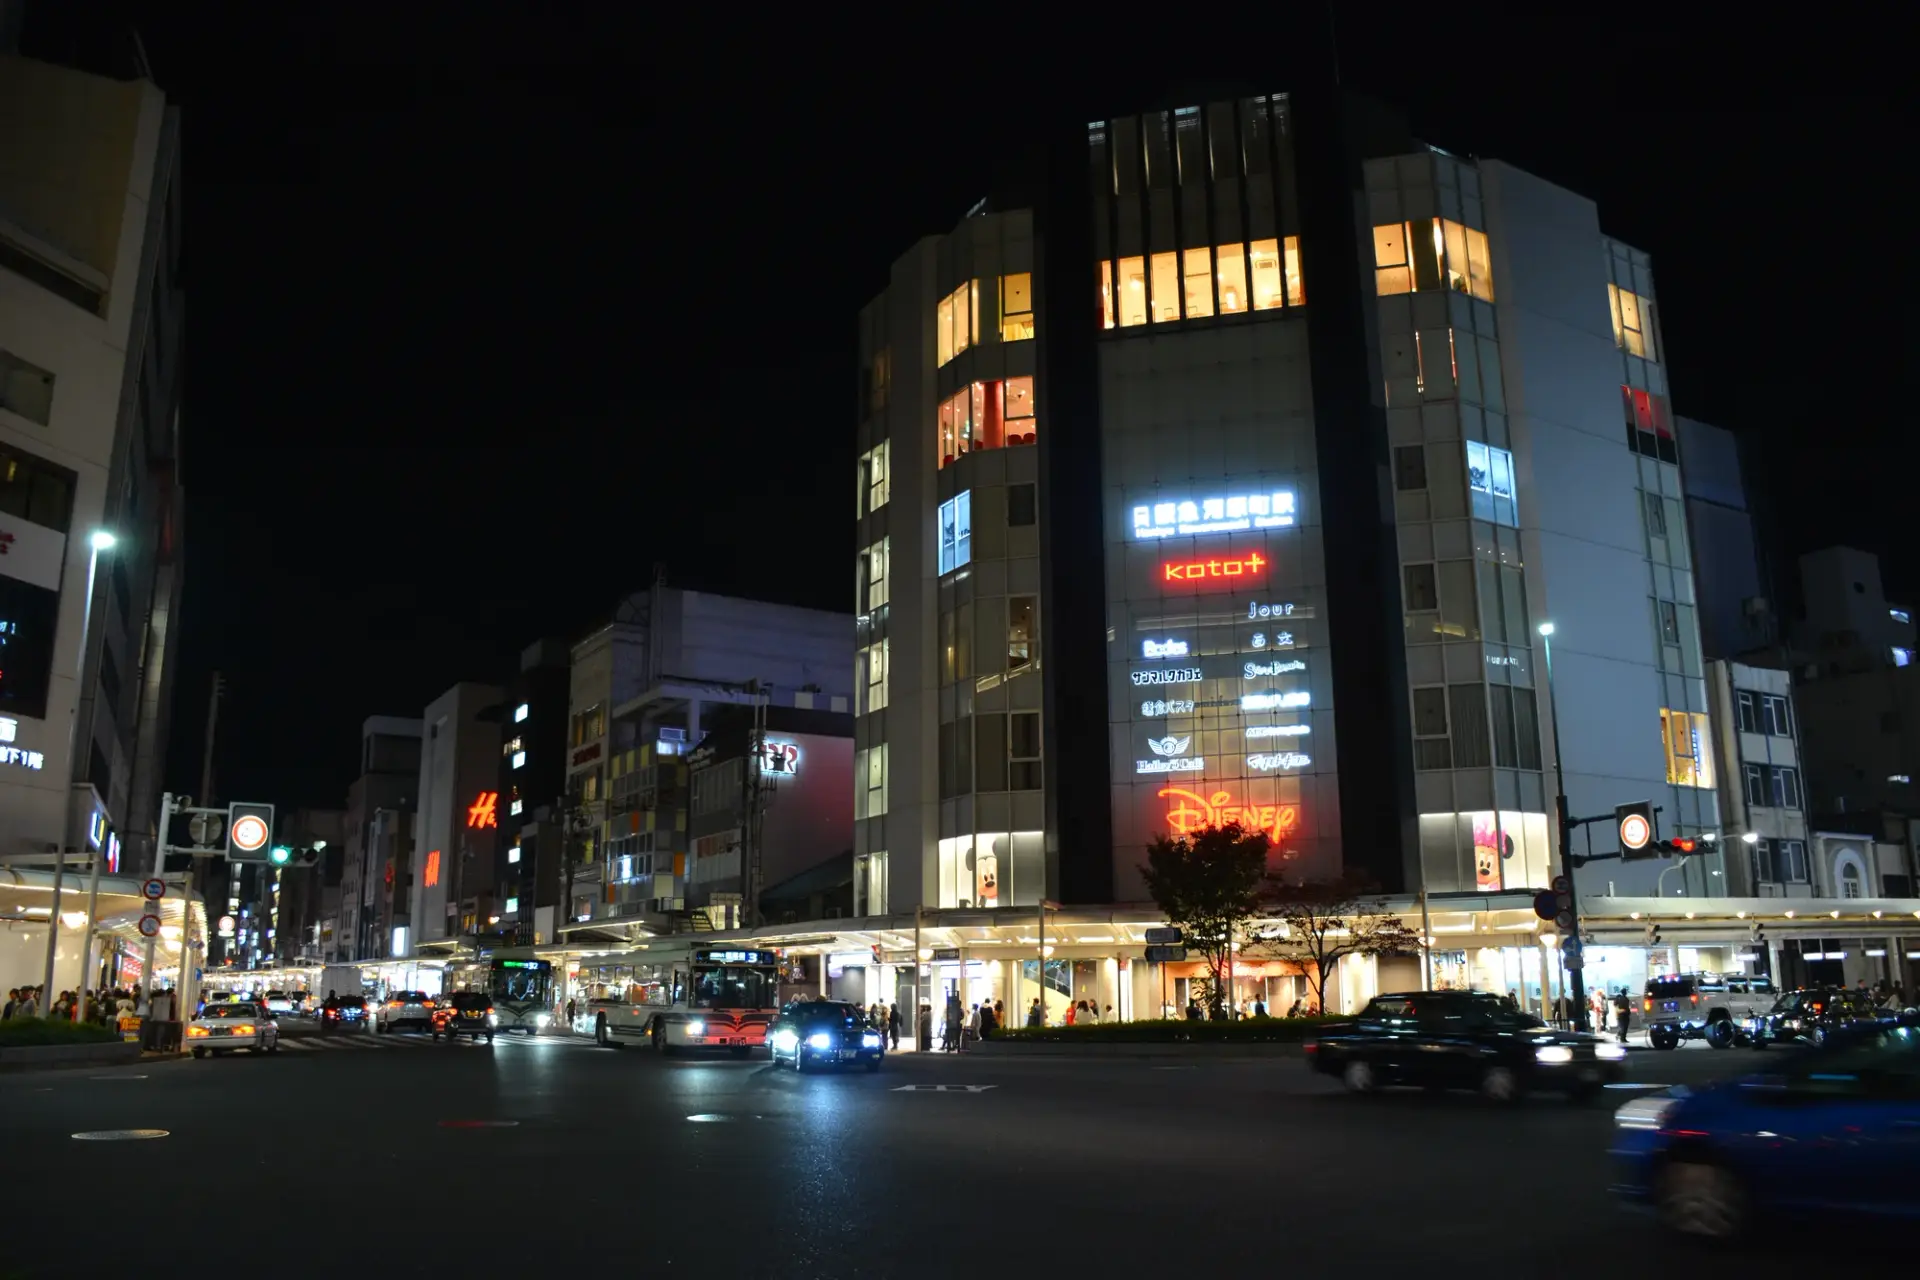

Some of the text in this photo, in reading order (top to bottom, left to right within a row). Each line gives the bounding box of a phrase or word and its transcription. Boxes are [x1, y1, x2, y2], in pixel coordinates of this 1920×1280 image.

[1132, 668, 1203, 685] サンマルクカフェ
